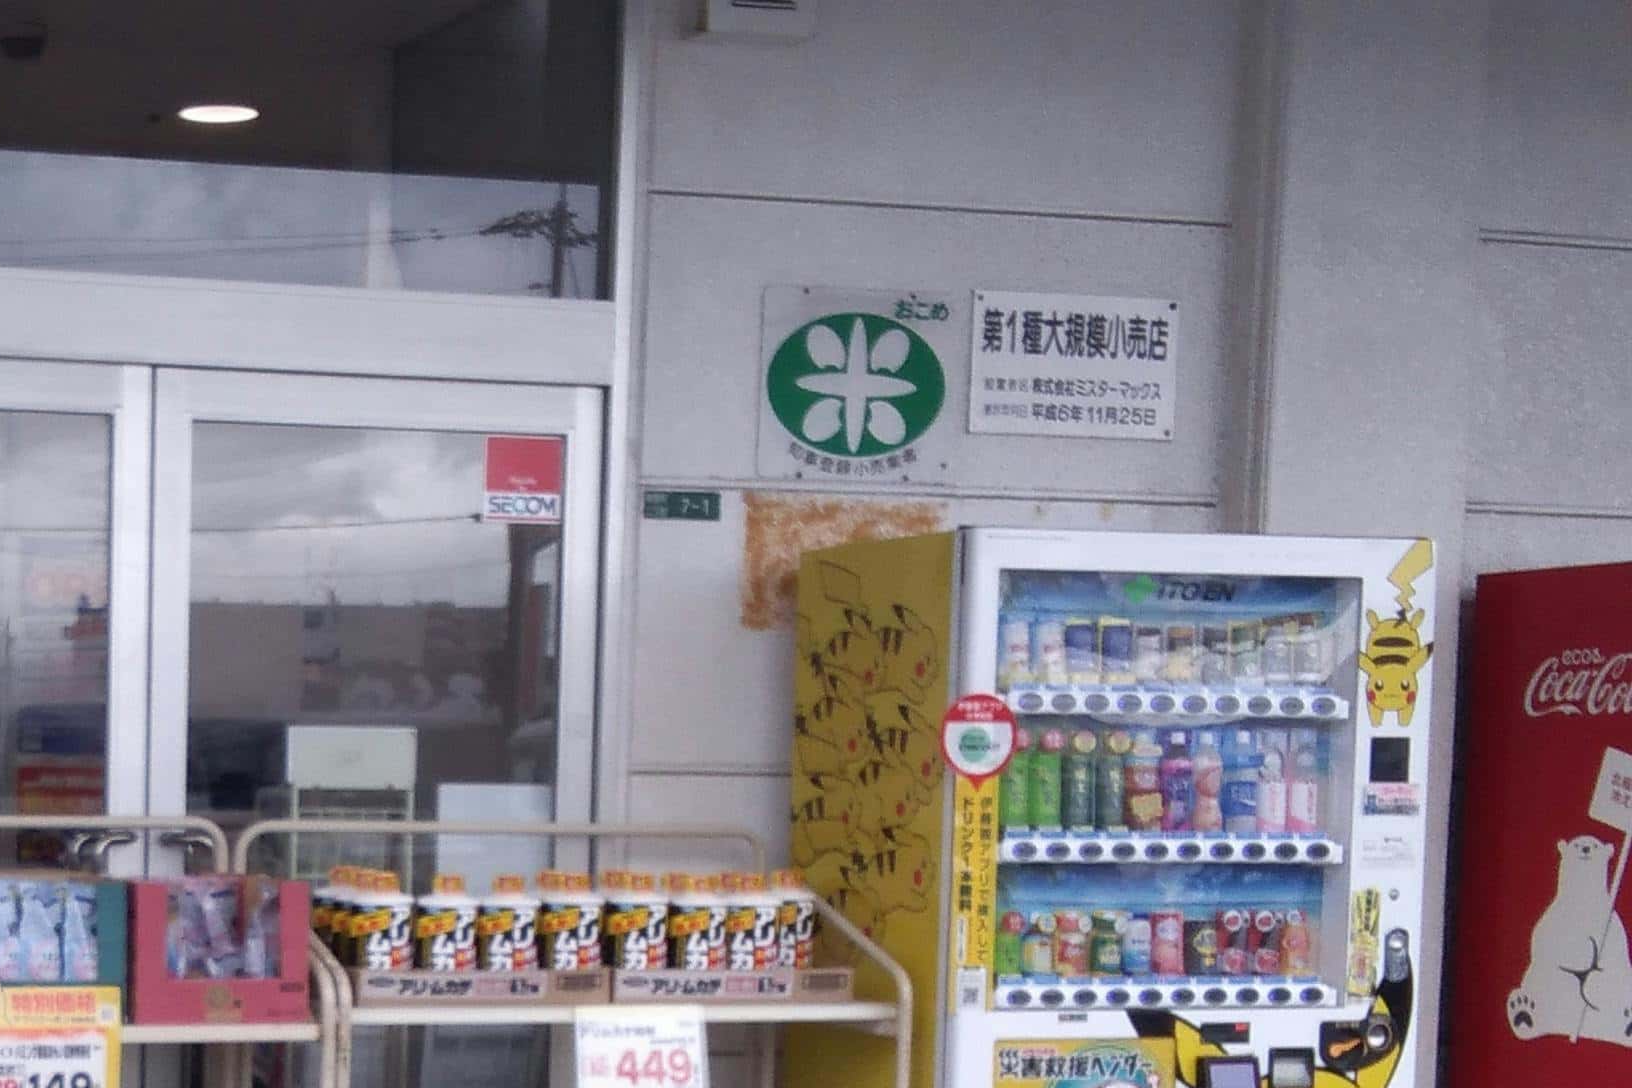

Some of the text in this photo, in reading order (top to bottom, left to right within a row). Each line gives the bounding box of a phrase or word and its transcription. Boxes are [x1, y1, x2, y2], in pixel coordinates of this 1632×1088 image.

[894, 300, 950, 322] おこめ
[981, 308, 1169, 362] 第1種大規模小売店
[1031, 376, 1162, 401] 株式会社ミスターマックス
[488, 496, 556, 516] SECOM
[615, 1048, 692, 1086] 449
